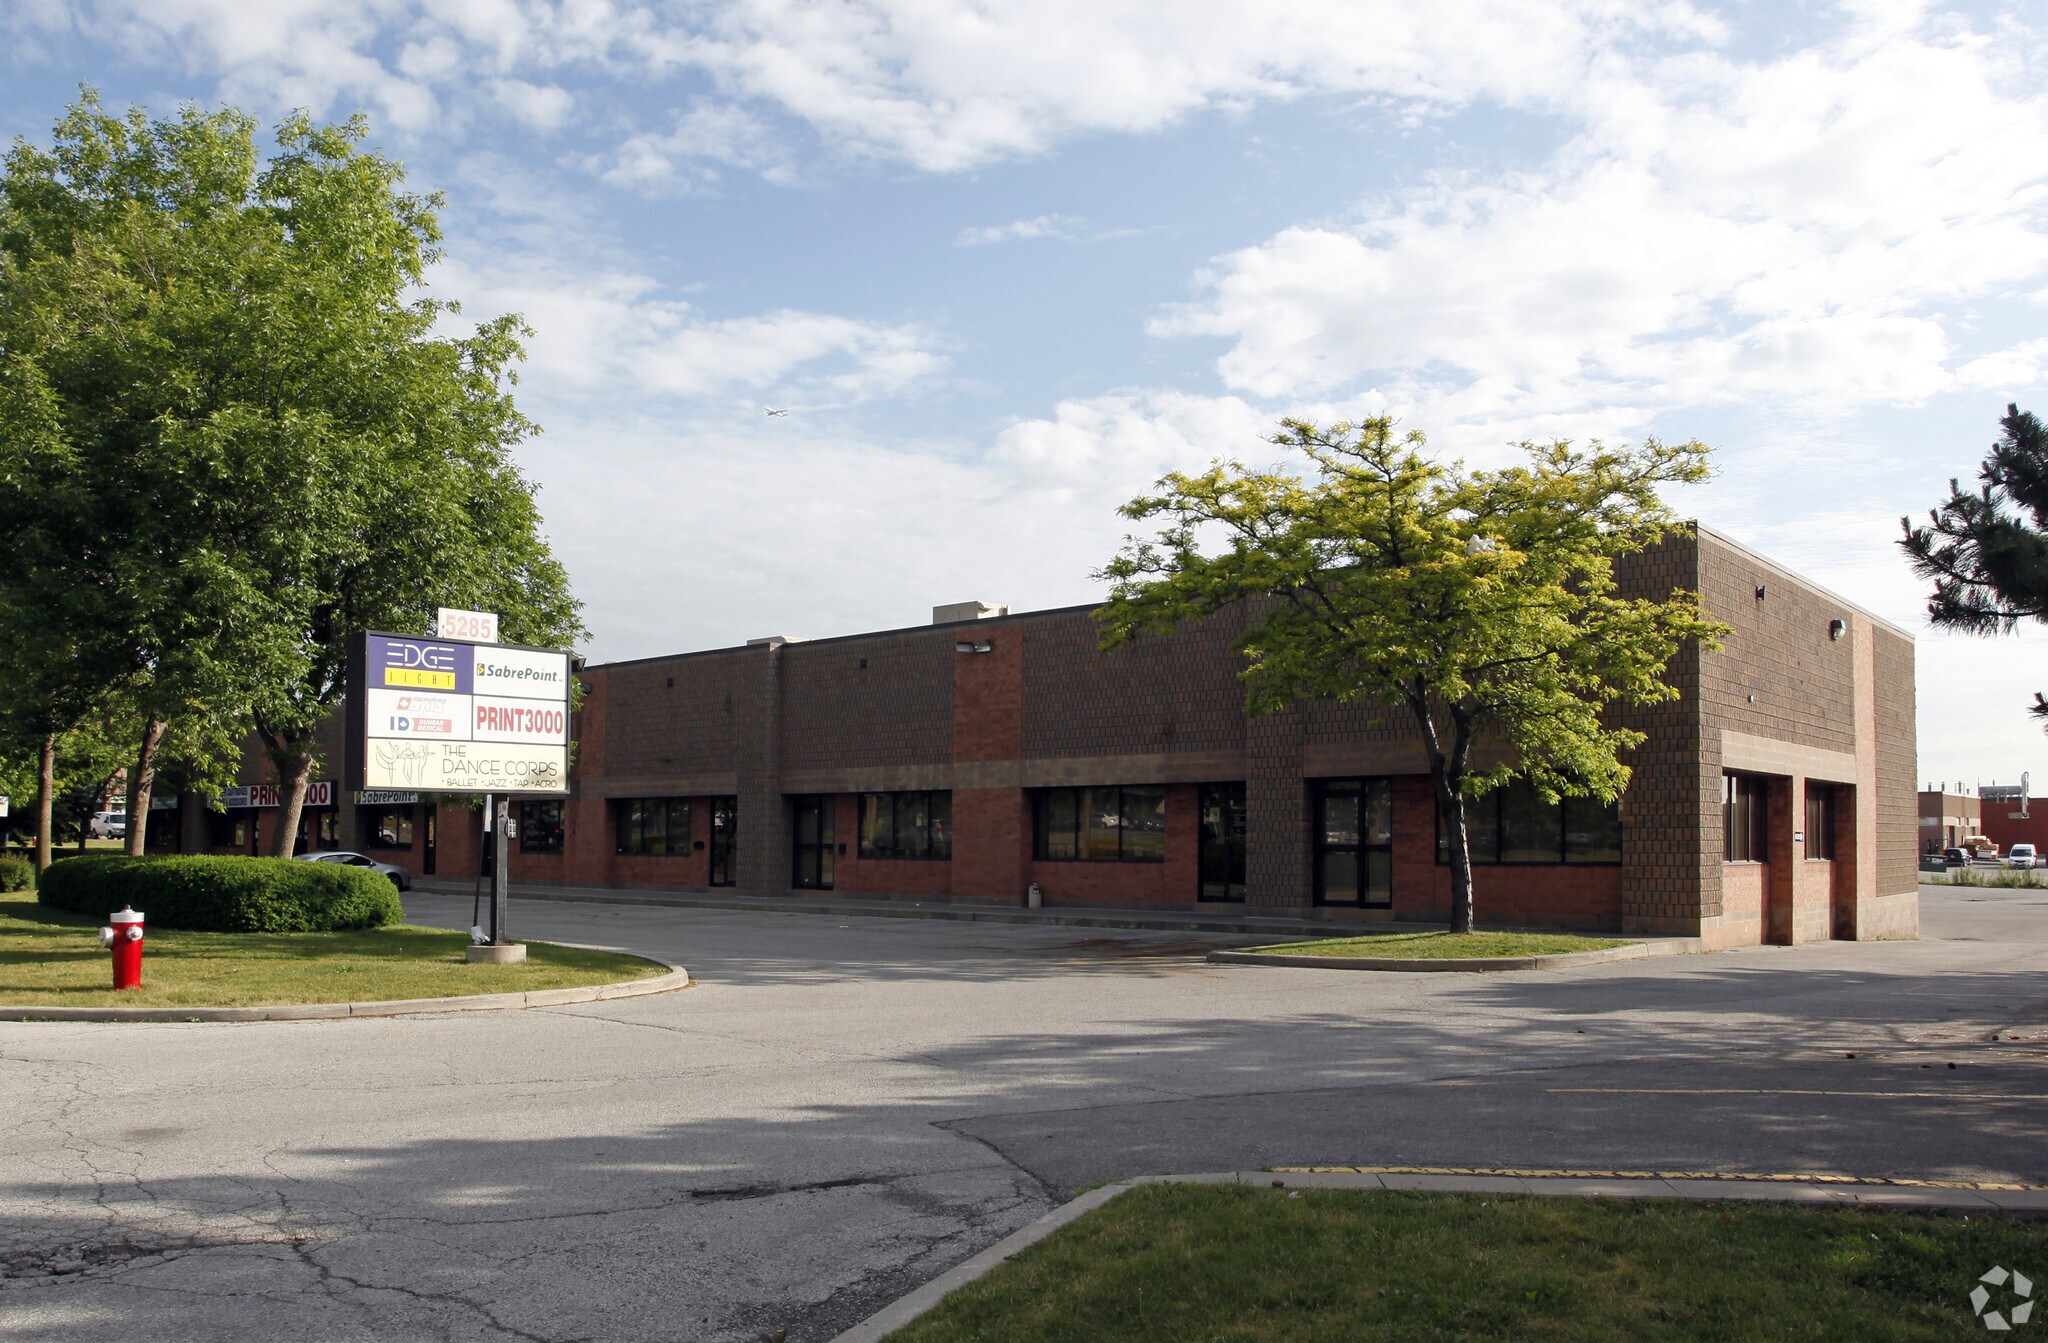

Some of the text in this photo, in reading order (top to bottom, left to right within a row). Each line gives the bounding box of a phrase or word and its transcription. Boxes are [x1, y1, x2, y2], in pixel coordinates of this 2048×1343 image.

[445, 614, 491, 639] 5285
[387, 642, 455, 670] EDGE
[487, 664, 557, 682] SabrePoint
[477, 706, 563, 734] PRINT3000
[442, 744, 466, 757] THE
[443, 759, 558, 776] DANCE CORPS
[447, 778, 558, 788] BALLET JAZZ TAP ACRO
